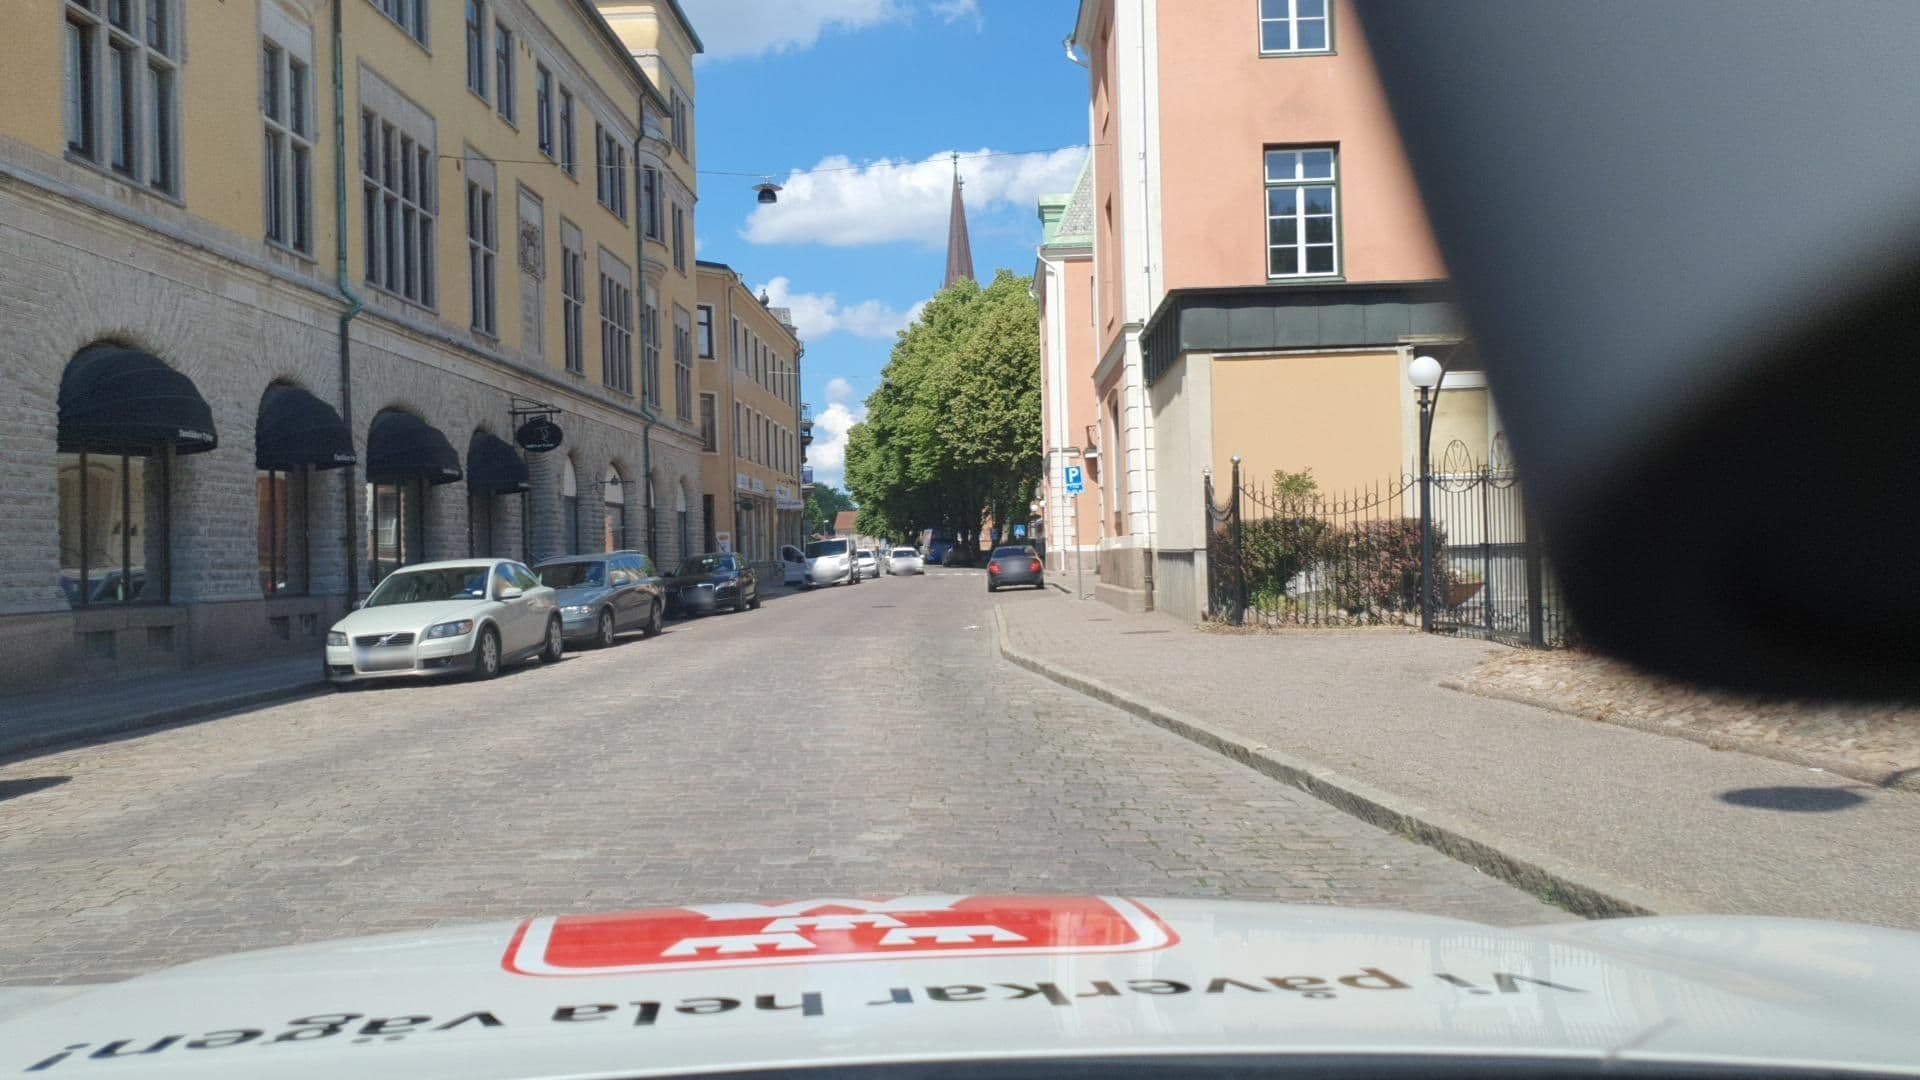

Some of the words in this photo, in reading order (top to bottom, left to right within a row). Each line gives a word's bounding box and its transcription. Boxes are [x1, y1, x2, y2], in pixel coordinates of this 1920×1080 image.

[1068, 468, 1079, 483] P
[865, 967, 1413, 1006] påverkar
[1434, 972, 1591, 995] Vi
[551, 990, 825, 1027] hela
[23, 1011, 505, 1073] vägen!
